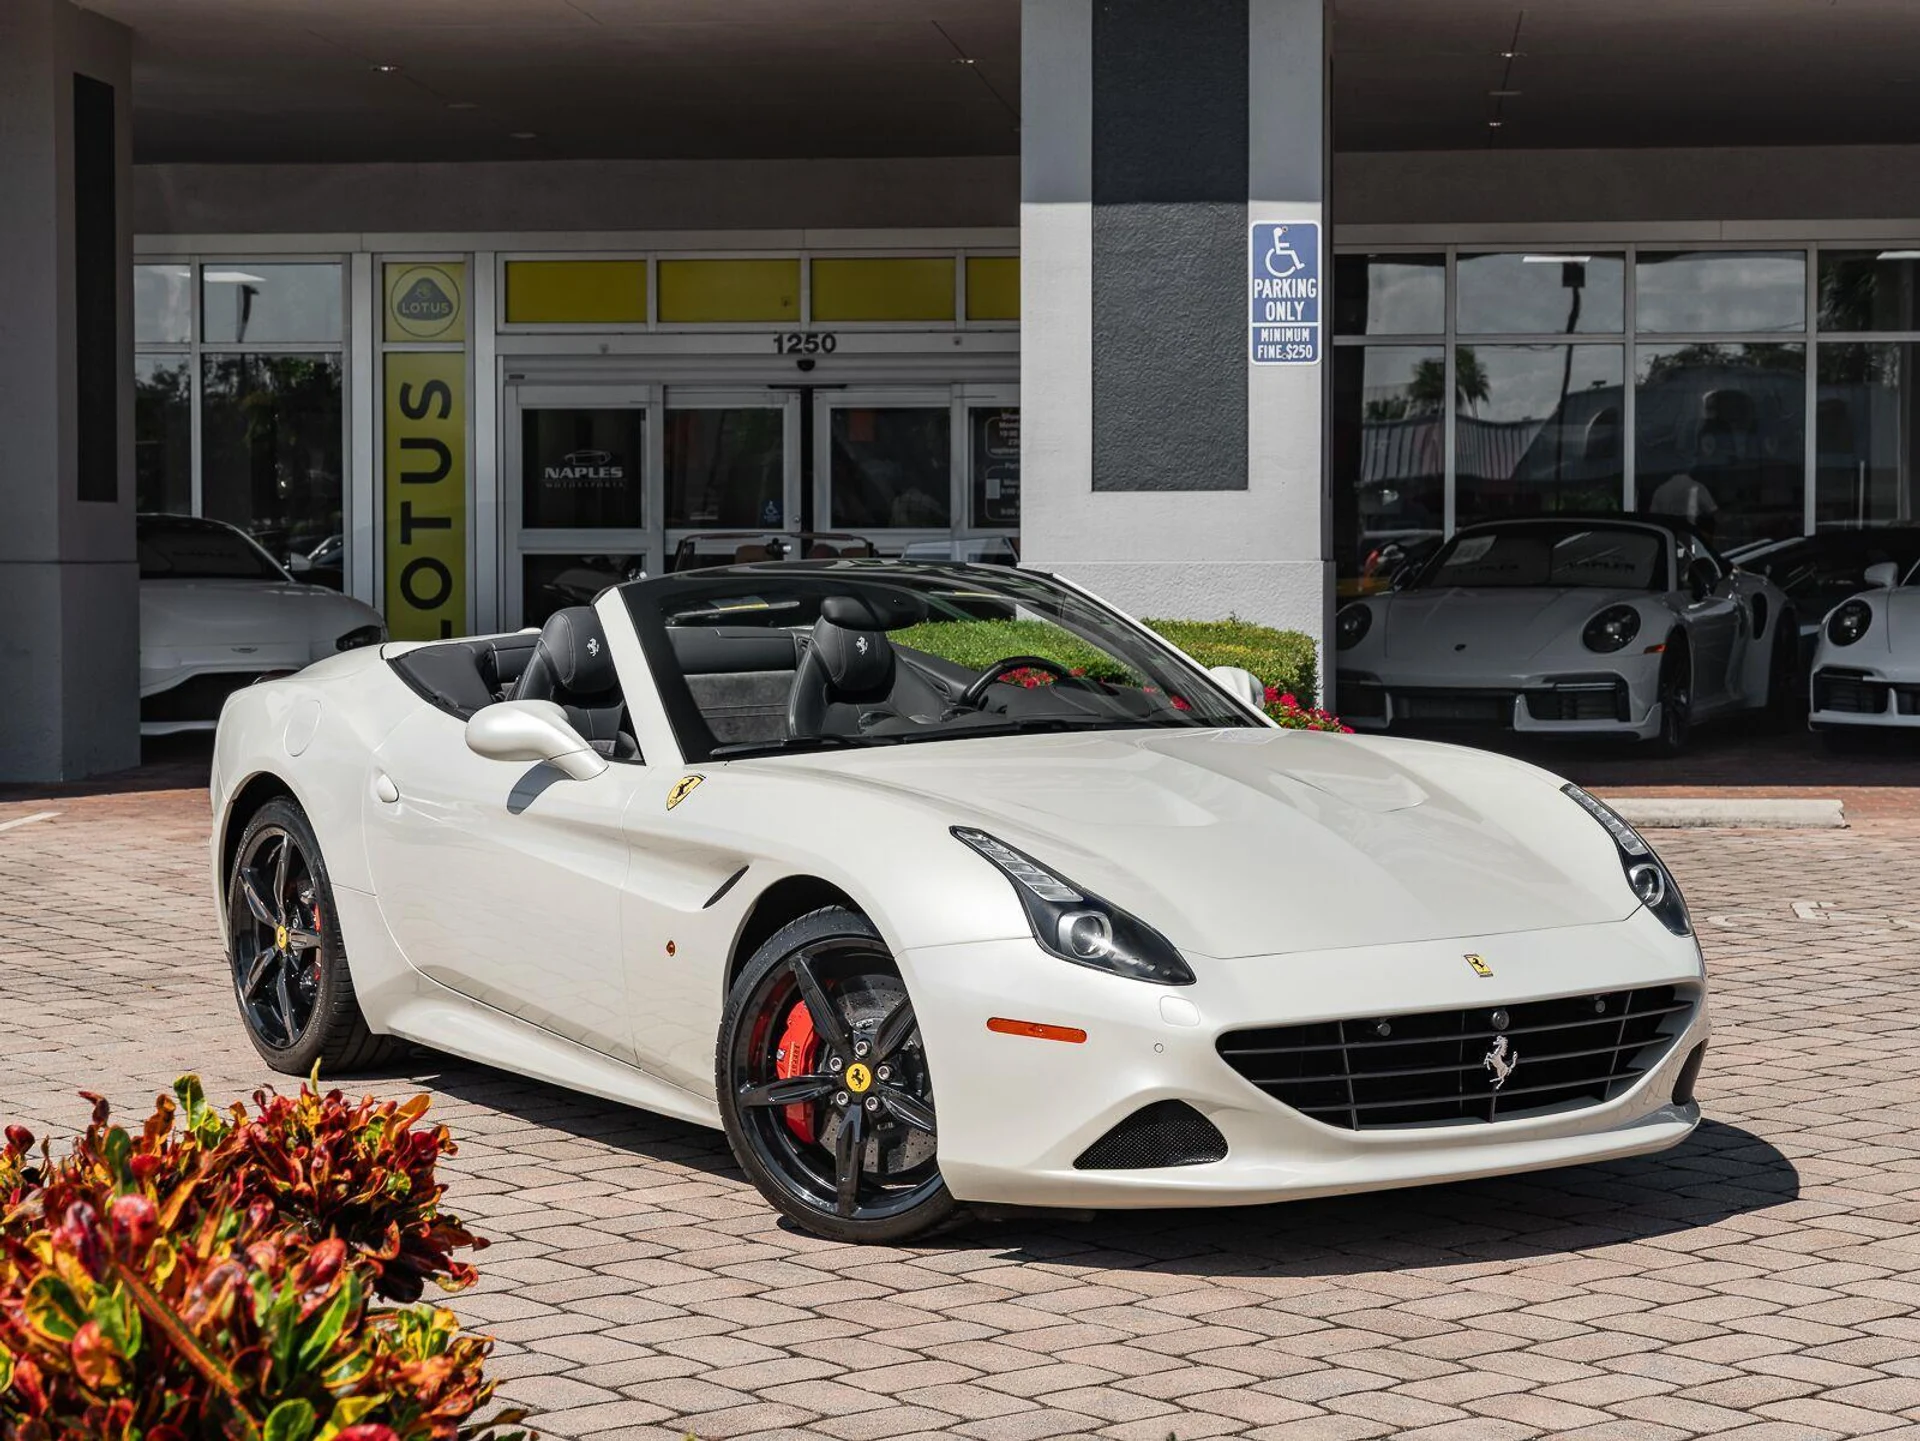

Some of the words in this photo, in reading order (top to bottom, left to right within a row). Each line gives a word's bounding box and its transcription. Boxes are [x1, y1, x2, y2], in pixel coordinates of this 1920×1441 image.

[1254, 278, 1316, 298] PARKING
[402, 302, 449, 313] LOTUS
[1266, 301, 1305, 321] ONLY
[773, 332, 836, 354] 1250
[1261, 328, 1309, 341] MINIMUM
[1257, 344, 1282, 358] FINE
[1286, 344, 1312, 359] $250
[544, 466, 623, 479] NAPLES
[400, 379, 452, 638] OTUS
